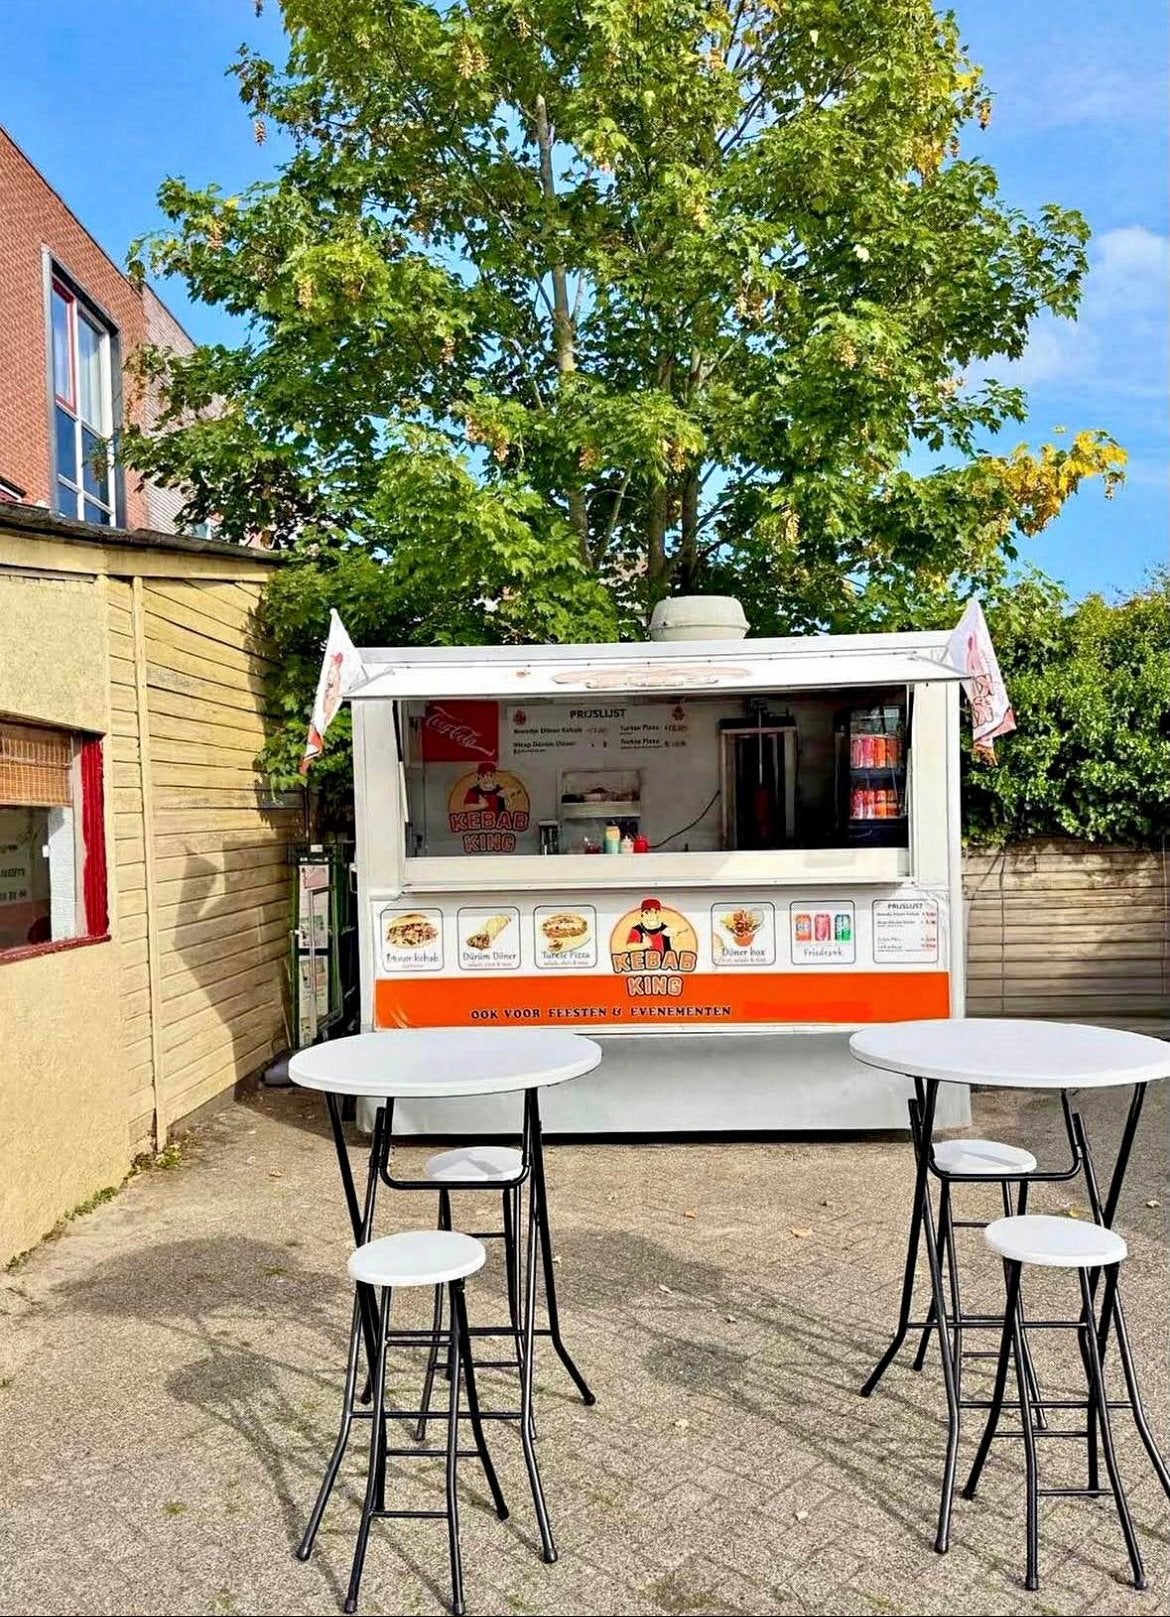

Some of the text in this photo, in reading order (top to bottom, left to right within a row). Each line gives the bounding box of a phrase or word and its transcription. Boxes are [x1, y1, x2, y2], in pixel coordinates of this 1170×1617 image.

[570, 708, 627, 719] PRIJSLIJST
[449, 811, 530, 833] KEBAB
[463, 833, 516, 853] KING
[462, 951, 517, 962] Dürüm Döner
[569, 950, 591, 960] Pizza
[722, 946, 766, 957] Döner box
[803, 947, 843, 957] Frisdrank
[611, 950, 698, 972] KEBAB
[627, 975, 684, 997] KING
[471, 1005, 732, 1020] OOK VOOR FEESTEN & EVENEMENTEN
